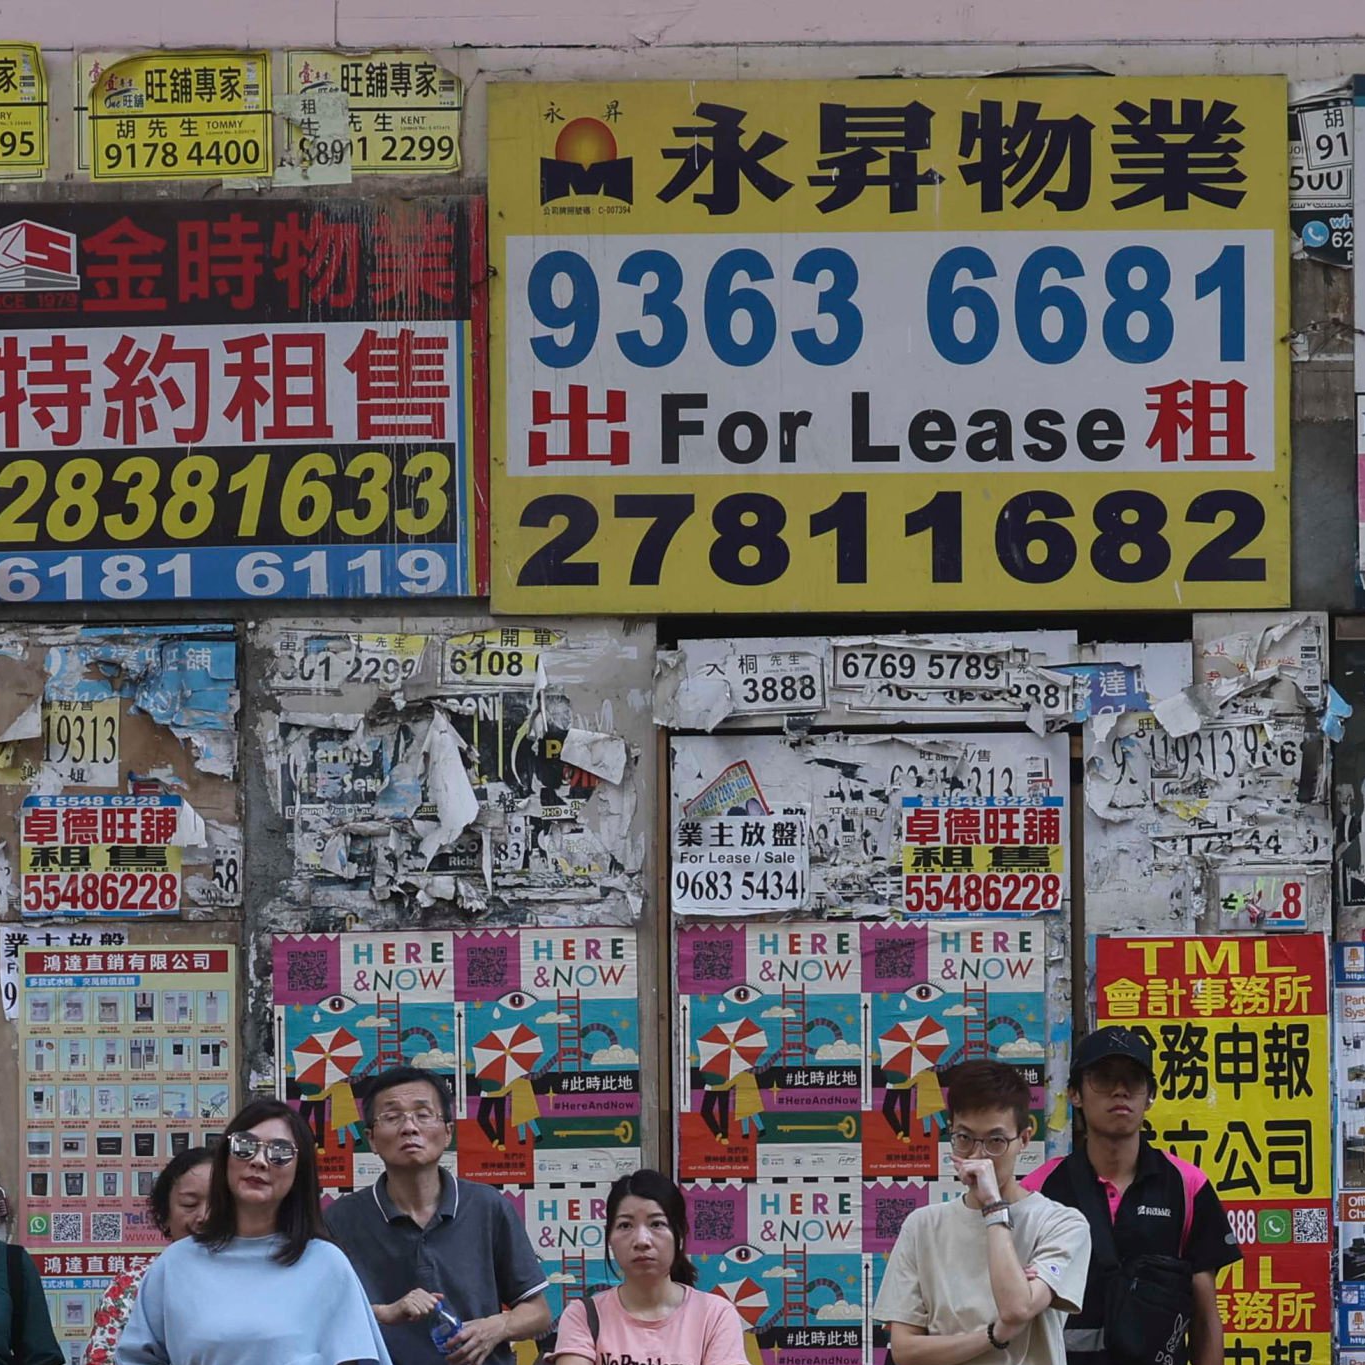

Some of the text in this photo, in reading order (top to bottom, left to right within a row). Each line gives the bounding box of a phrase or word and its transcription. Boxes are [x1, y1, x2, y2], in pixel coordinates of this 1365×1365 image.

[145, 67, 242, 104] 旺舖專家
[341, 63, 437, 99] 旺舖專家
[117, 119, 243, 138] 胡先生 TOMMY
[400, 117, 427, 125] KENT
[105, 142, 178, 169] 9178
[188, 139, 260, 167] 4400
[658, 99, 1247, 215] 永昇物業
[82, 214, 457, 312] 金時物業
[528, 244, 1245, 368] 9363 6681
[528, 379, 1255, 467] 出 For Lease 租
[516, 490, 1267, 588] 27811682
[236, 549, 447, 596] 6119
[450, 650, 523, 677] 6108
[842, 651, 1001, 682] 6769 5789
[743, 676, 817, 704] 3888
[56, 796, 161, 807] 5548 6228
[23, 808, 177, 846] 卓德旺舖
[679, 821, 799, 848] 業主放盤
[905, 808, 1061, 846] 卓德旺舖
[30, 845, 168, 868] 租售
[679, 852, 796, 866] For Lease Sale
[24, 873, 178, 911] 55486228
[676, 867, 798, 903] 9683 5434
[905, 873, 1061, 912] 55486228
[353, 941, 445, 965] HERE
[533, 938, 625, 961] HERE
[758, 931, 851, 956] HERE
[941, 930, 1033, 955] HERE
[42, 952, 211, 972] 鴻達直銷有限公司
[941, 958, 1033, 983] &NOW
[1126, 941, 1299, 975] TML
[353, 967, 446, 991] &NOW
[534, 965, 626, 989] &NOW
[759, 959, 853, 983] &NOW
[1103, 976, 1313, 1016] 會計事務所
[561, 1073, 633, 1094] #此時此地
[784, 1068, 858, 1088] #此時此地
[553, 1100, 635, 1112] #HereAndNow
[778, 1095, 858, 1106] #HereAndNow
[761, 1193, 852, 1216] HERE
[760, 1219, 855, 1243] &NOW
[785, 1329, 859, 1348] #此時此地
